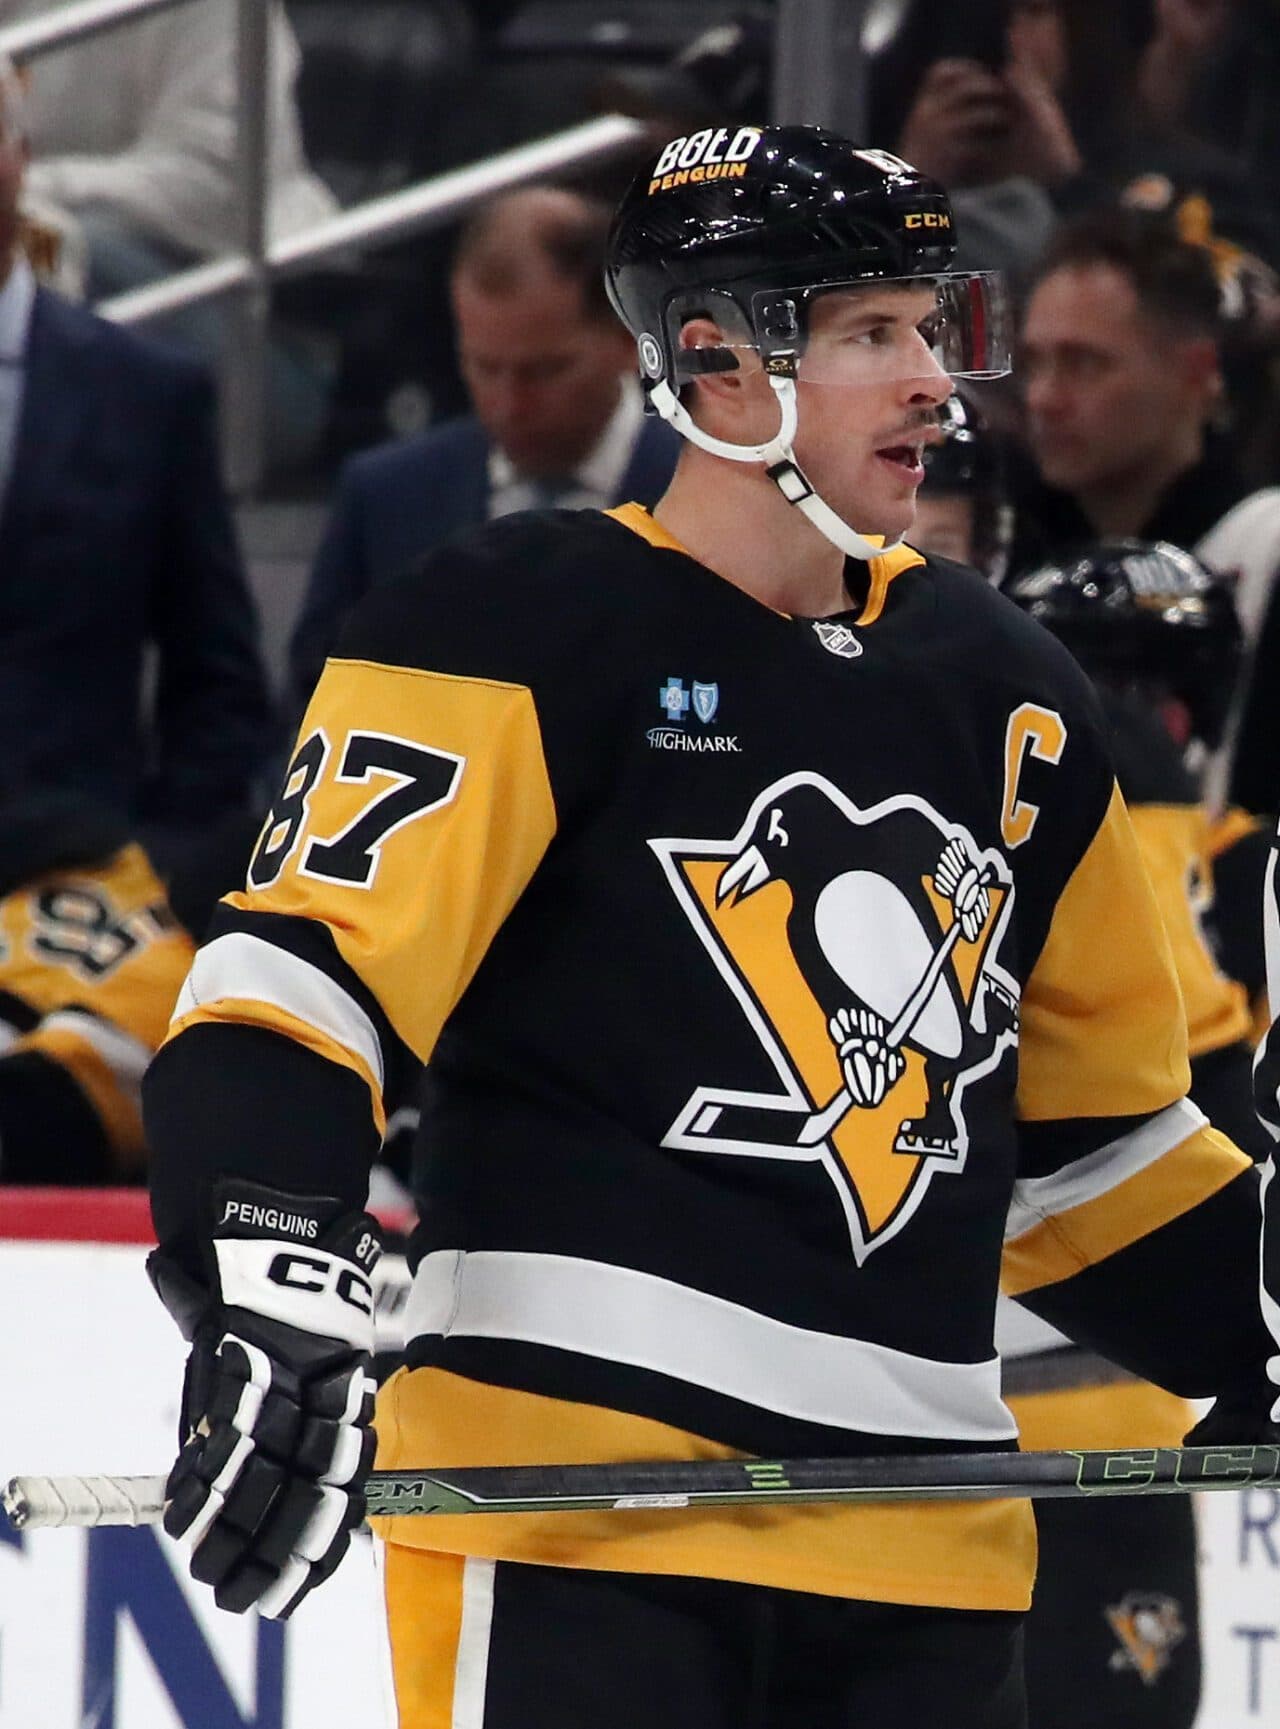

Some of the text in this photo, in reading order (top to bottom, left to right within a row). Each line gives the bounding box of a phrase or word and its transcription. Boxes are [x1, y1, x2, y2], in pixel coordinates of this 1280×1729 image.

[653, 127, 763, 178] BOLD
[648, 162, 748, 196] PENGUIN
[904, 213, 951, 229] CCM
[1001, 702, 1067, 849] C
[246, 726, 466, 891] 87
[219, 1201, 319, 1238] PENGUINS
[355, 1232, 382, 1264] 87
